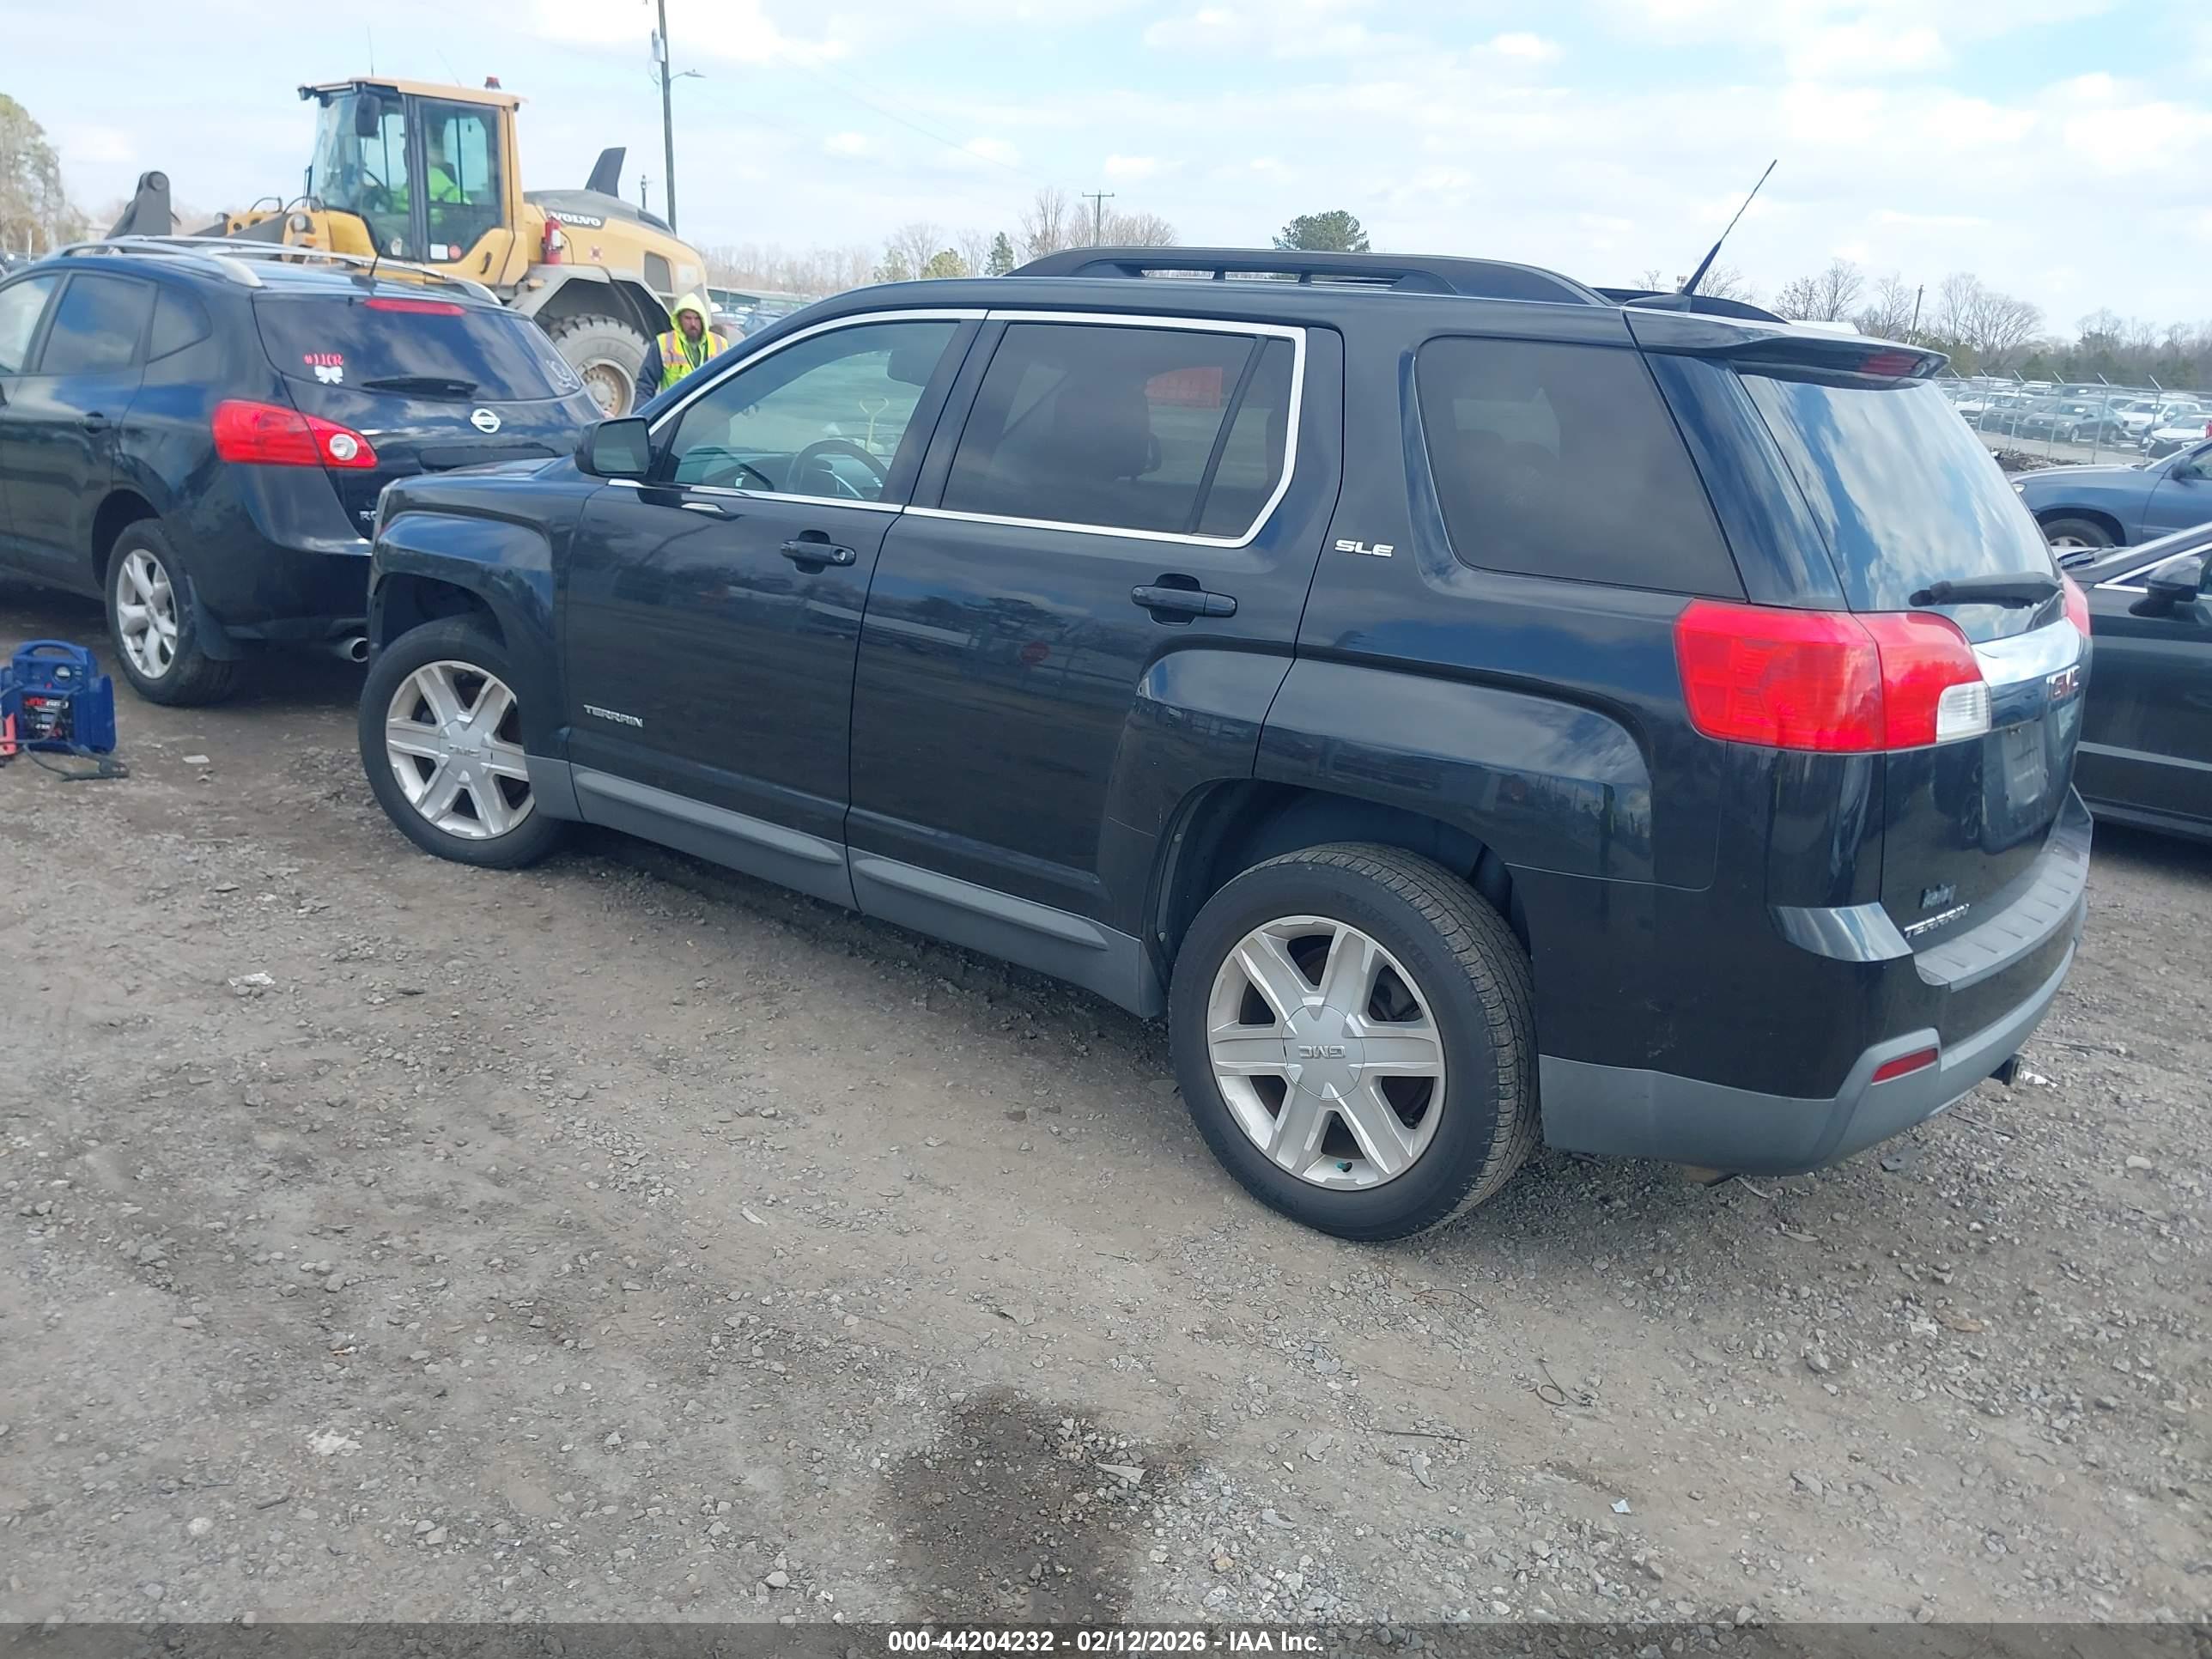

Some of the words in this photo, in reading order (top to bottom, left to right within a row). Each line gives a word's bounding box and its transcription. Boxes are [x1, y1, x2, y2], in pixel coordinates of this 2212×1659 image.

[548, 210, 601, 227] VOLVO
[1334, 539, 1395, 557] SLE
[583, 703, 643, 727] TERRAIN
[1904, 903, 1970, 939] TERRAIN
[1297, 1045, 1346, 1059] GMC
